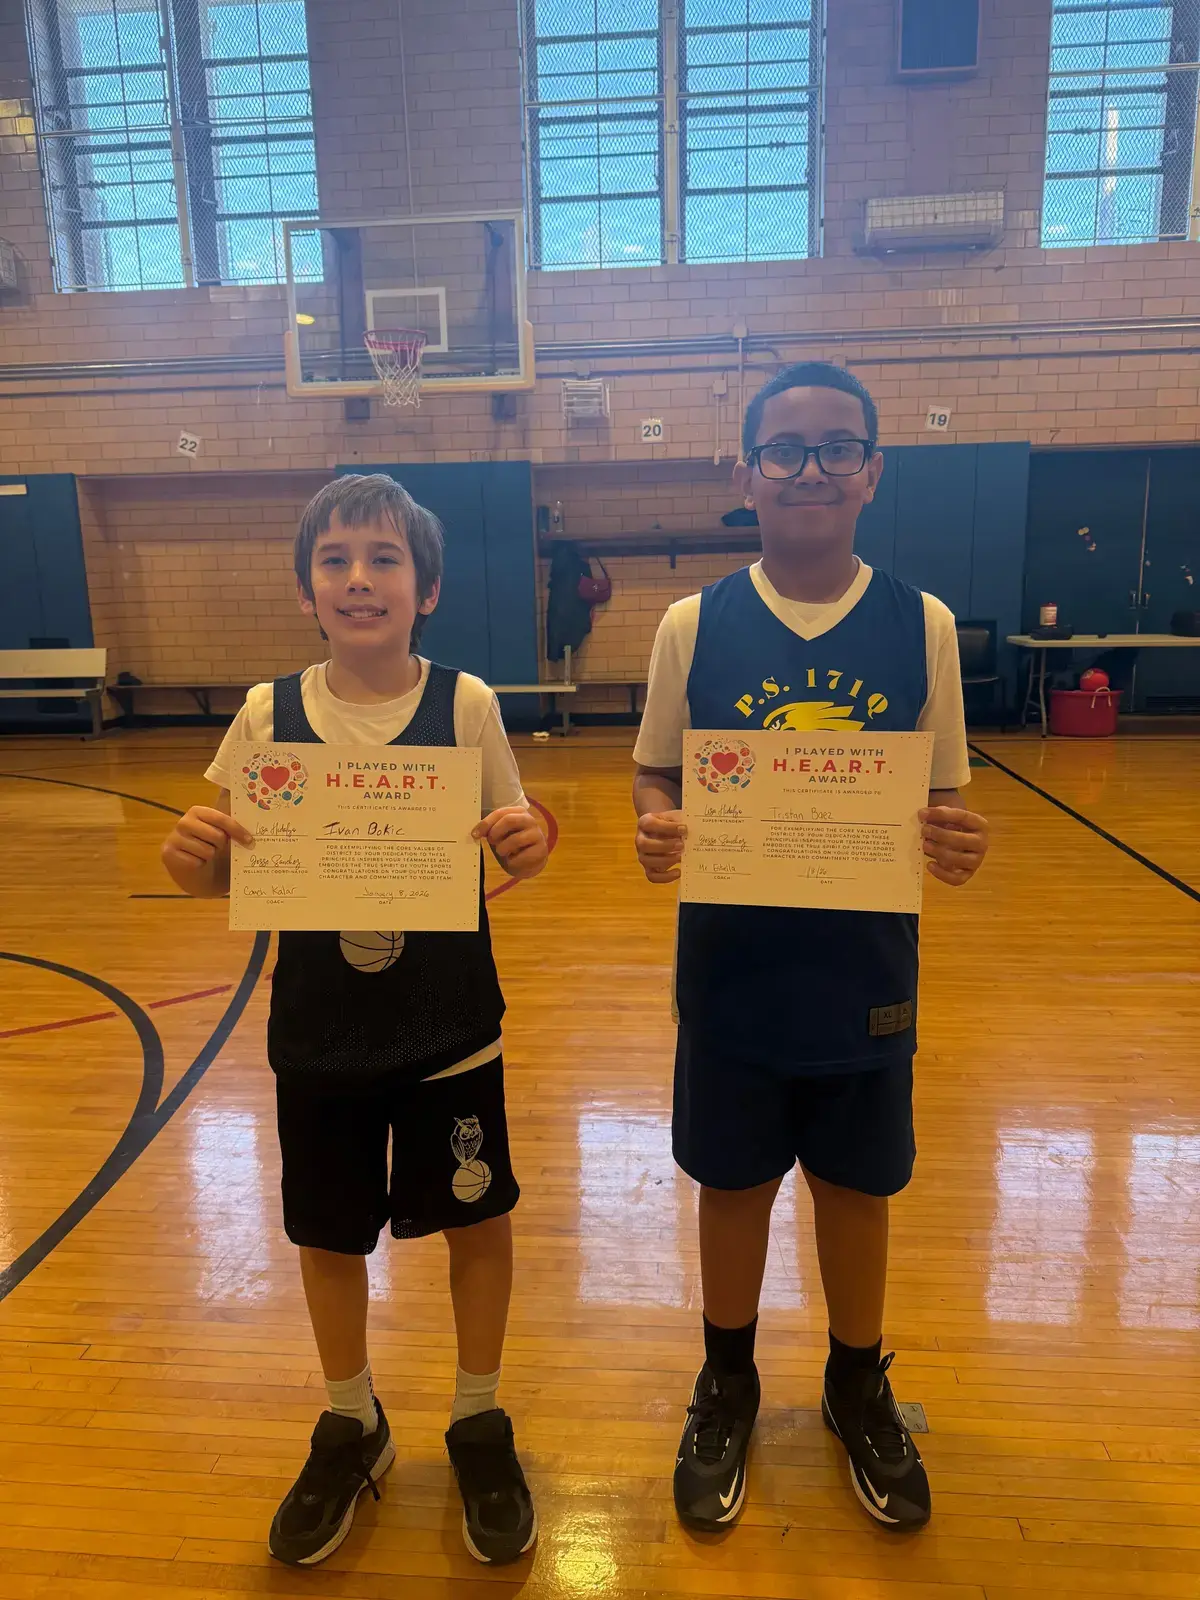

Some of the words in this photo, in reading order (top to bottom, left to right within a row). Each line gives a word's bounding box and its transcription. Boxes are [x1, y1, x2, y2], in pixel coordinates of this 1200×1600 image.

[929, 413, 947, 426] 19
[643, 424, 661, 437] 20
[179, 437, 197, 453] 22
[734, 676, 790, 718] P.S.
[785, 747, 789, 755] I
[795, 748, 845, 756] PLAYED
[850, 748, 884, 757] WITH
[338, 762, 342, 770] I
[347, 762, 397, 771] PLAYED
[402, 763, 435, 772] WITH
[773, 758, 893, 774] H.E.A.R.T.
[326, 773, 446, 790] H.E.A.R.T.
[808, 775, 857, 784] AWARD
[363, 791, 411, 800] AWARD
[769, 806, 804, 820] Tristan
[811, 807, 834, 820] Baez
[322, 821, 360, 836] Ivan
